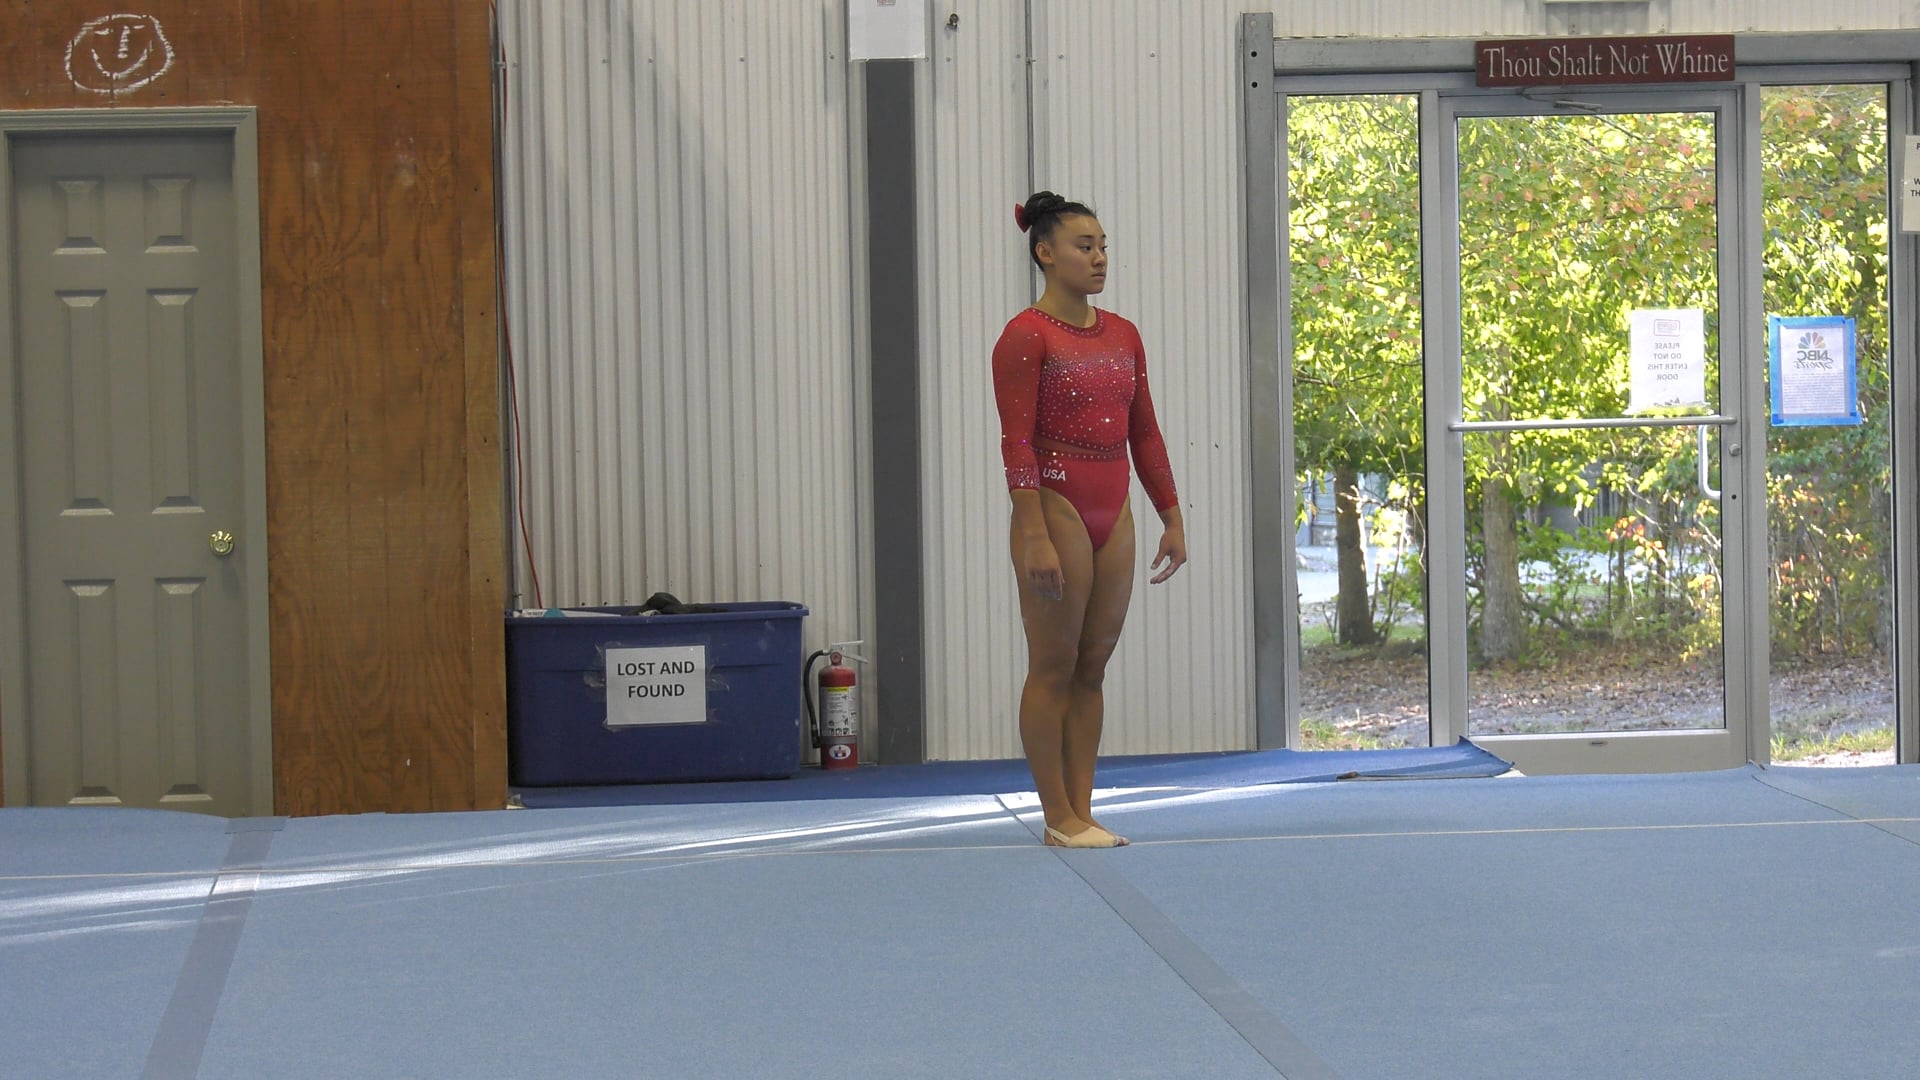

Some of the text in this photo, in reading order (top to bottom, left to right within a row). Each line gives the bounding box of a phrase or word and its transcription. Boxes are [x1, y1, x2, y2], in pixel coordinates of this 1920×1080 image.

[1483, 42, 1729, 78] Thou Shalt Not Whine
[1042, 468, 1066, 481] USA
[617, 661, 695, 676] LOST AND
[628, 684, 685, 698] FOUND
